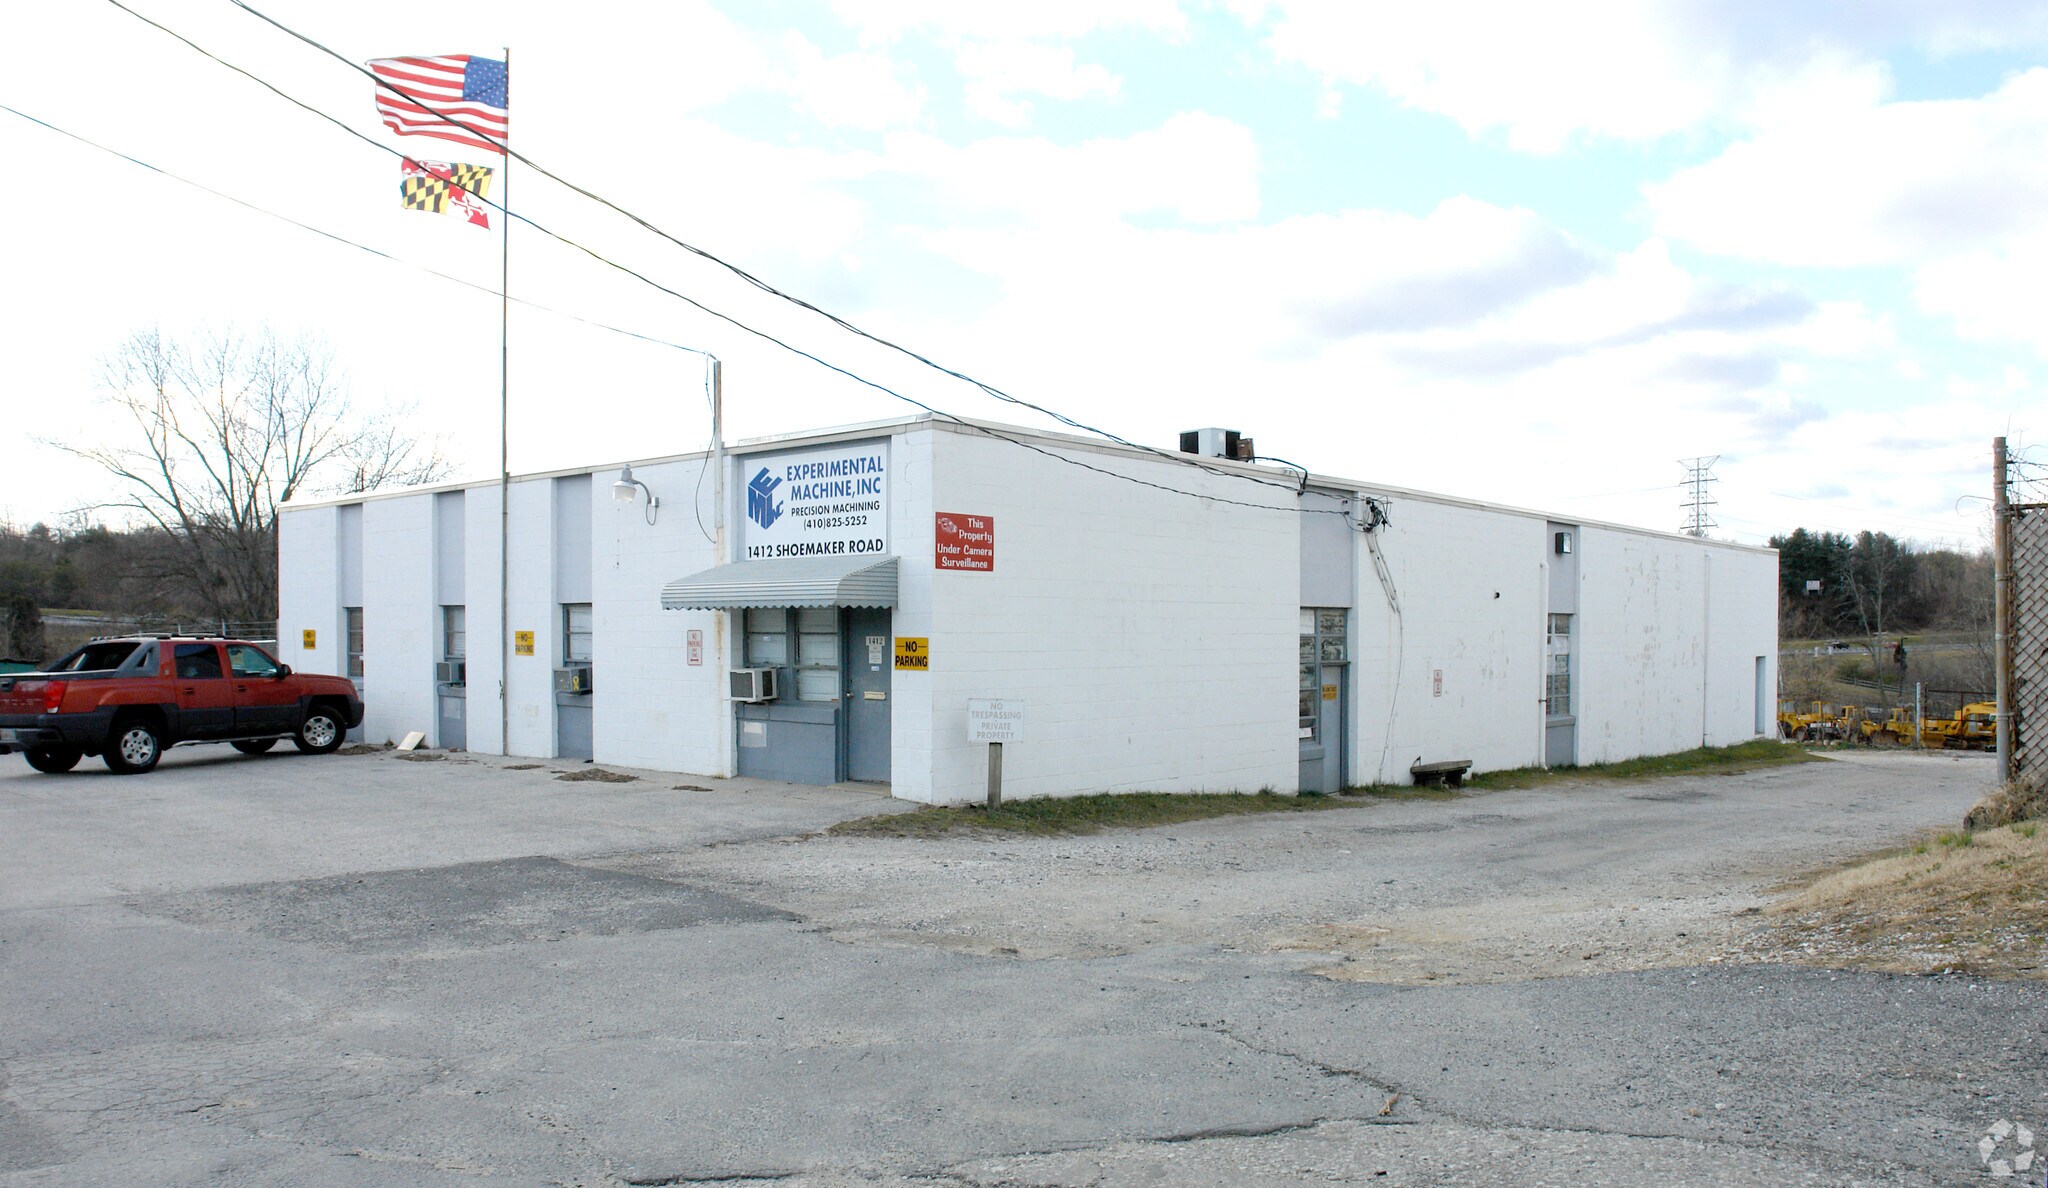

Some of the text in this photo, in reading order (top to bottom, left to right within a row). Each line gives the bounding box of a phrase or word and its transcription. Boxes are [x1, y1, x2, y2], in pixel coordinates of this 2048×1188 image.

[787, 456, 884, 482] EXPERIMENTAL
[791, 500, 880, 517] PRECISION MACHINING
[803, 515, 867, 531] (410)825-5252
[968, 517, 984, 529] This
[959, 529, 993, 544] Property
[748, 538, 884, 558] 1412 SHOEMAKER ROAD
[937, 543, 993, 556] Under Camera
[941, 556, 988, 569] Surveillance
[868, 637, 883, 645] 1412
[905, 641, 918, 652] NO
[895, 655, 928, 667] PARKING
[990, 702, 1003, 710] NO
[971, 710, 1022, 720] TRESPASSING
[981, 722, 1011, 731] PRIVATE
[976, 731, 1015, 740] PROPERTY
